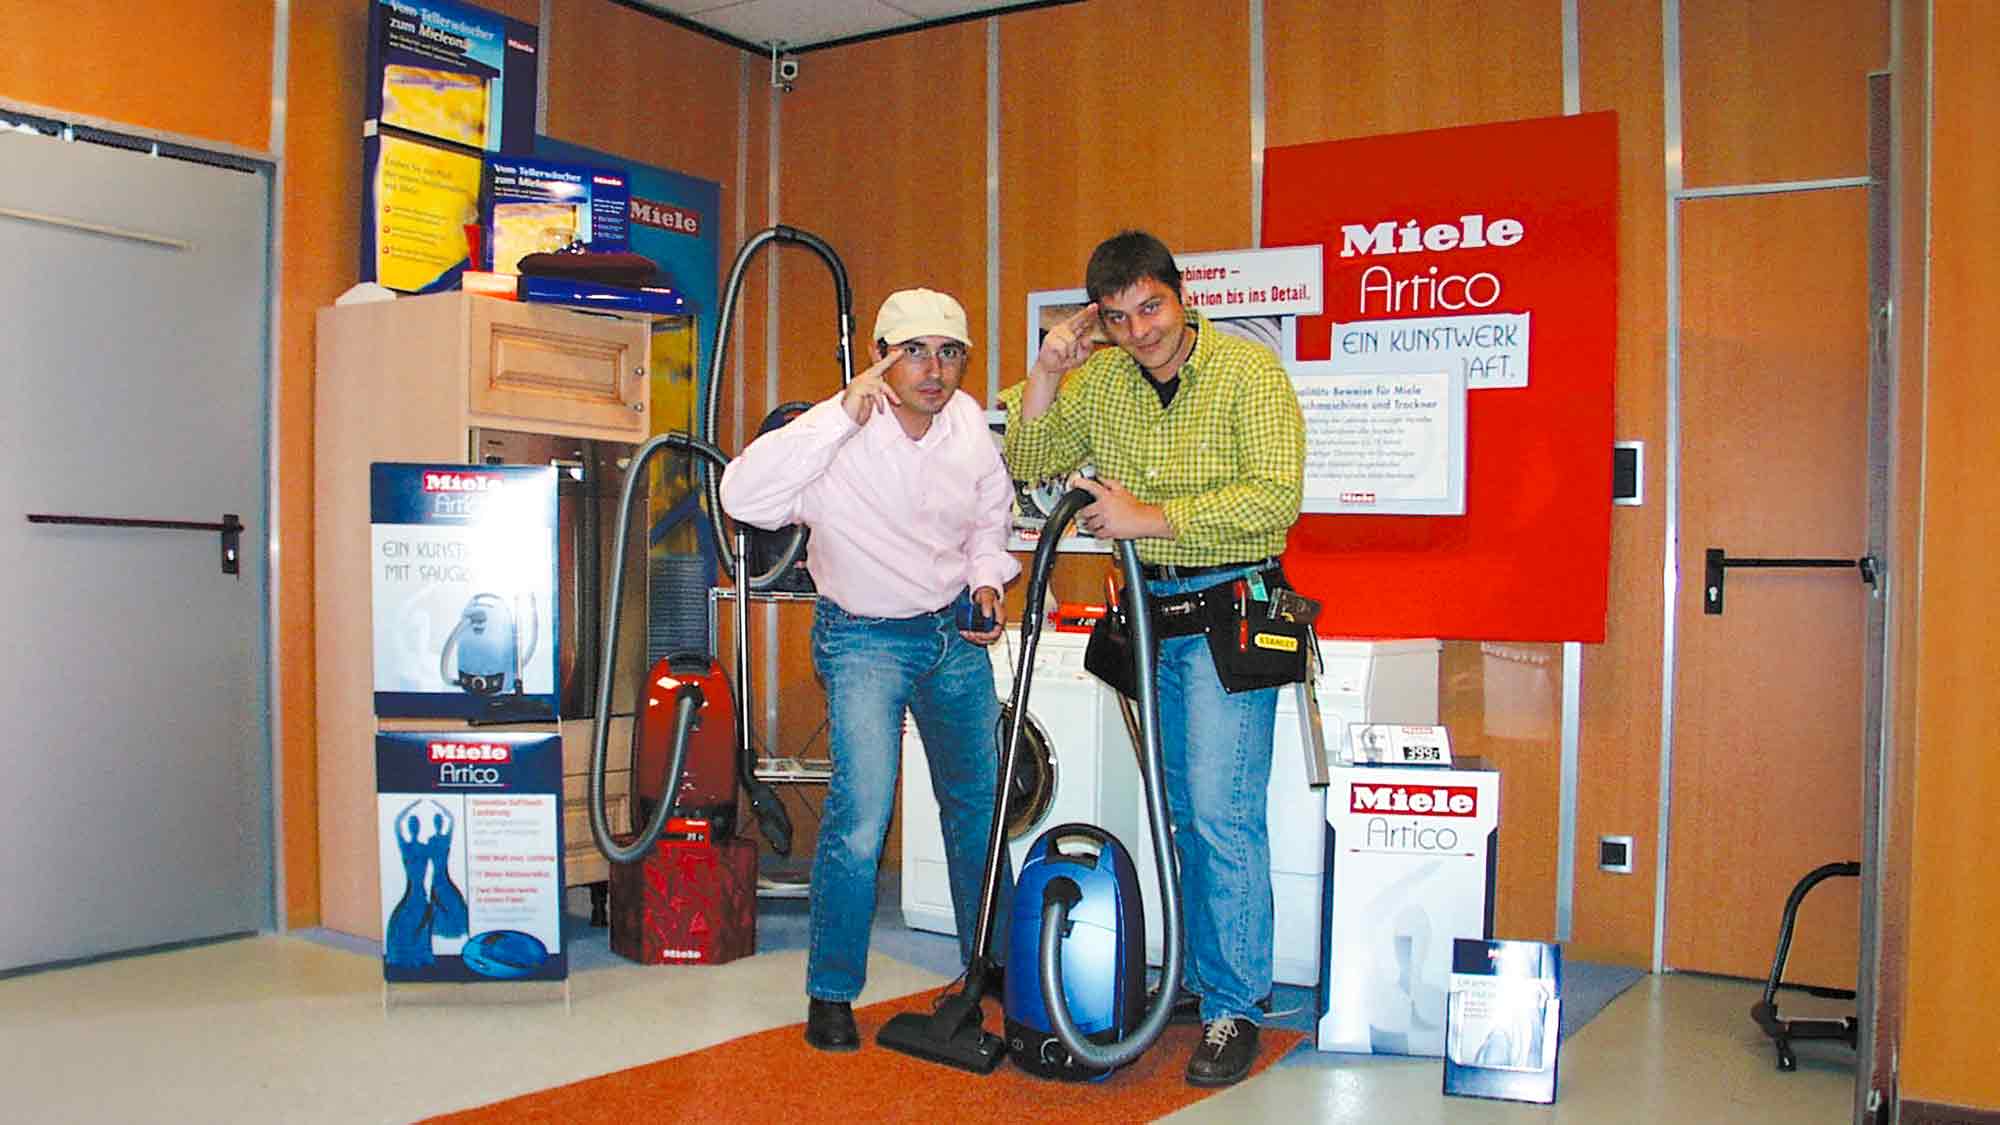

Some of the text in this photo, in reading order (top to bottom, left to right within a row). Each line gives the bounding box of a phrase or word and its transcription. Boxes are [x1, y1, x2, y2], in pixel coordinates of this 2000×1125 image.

[631, 201, 697, 233] Miele
[1340, 214, 1524, 257] Miele
[1227, 288, 1245, 304] bis
[1249, 286, 1266, 302] ins
[1271, 284, 1311, 301] Detail.
[1360, 265, 1500, 314] Artico
[1343, 323, 1518, 354] EIN KUNSTWERK
[1463, 354, 1514, 380] AFT.
[382, 541, 409, 557] EIN
[385, 563, 411, 580] MIT
[432, 744, 508, 760] Miele
[440, 762, 499, 784] Artico
[1353, 785, 1474, 814] Miele
[1367, 817, 1458, 850] Artico
